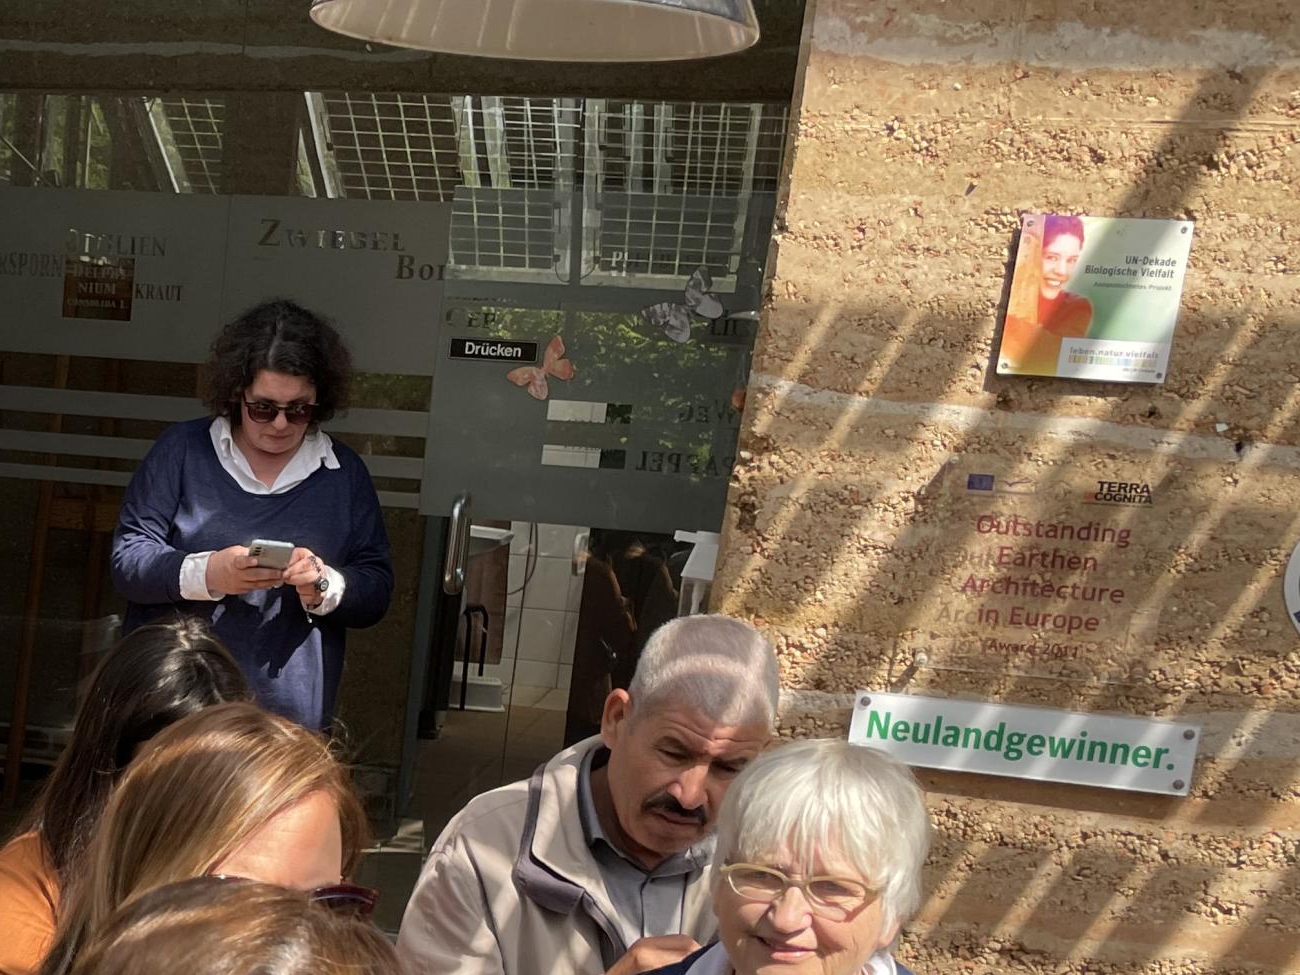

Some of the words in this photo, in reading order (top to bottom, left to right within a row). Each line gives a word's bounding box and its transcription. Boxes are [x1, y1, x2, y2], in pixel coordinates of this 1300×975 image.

[258, 218, 406, 251] ZWIEBEL
[1125, 255, 1177, 267] UN-Dekade
[1085, 264, 1138, 277] Biologische
[1141, 266, 1174, 279] Vielfalt
[77, 282, 116, 296] NIUM
[135, 283, 184, 302] KRAUT
[465, 341, 522, 358] Drücken
[1098, 481, 1151, 495] TERRA
[1094, 492, 1153, 505] COGNITA
[976, 514, 1131, 549] Outstanding
[997, 546, 1099, 572] Earthen
[961, 574, 1125, 604] Architecture
[977, 604, 999, 624] in
[1008, 606, 1100, 634] Europe
[988, 639, 1036, 653] Award
[866, 709, 1175, 771] Neulandgewinner.
